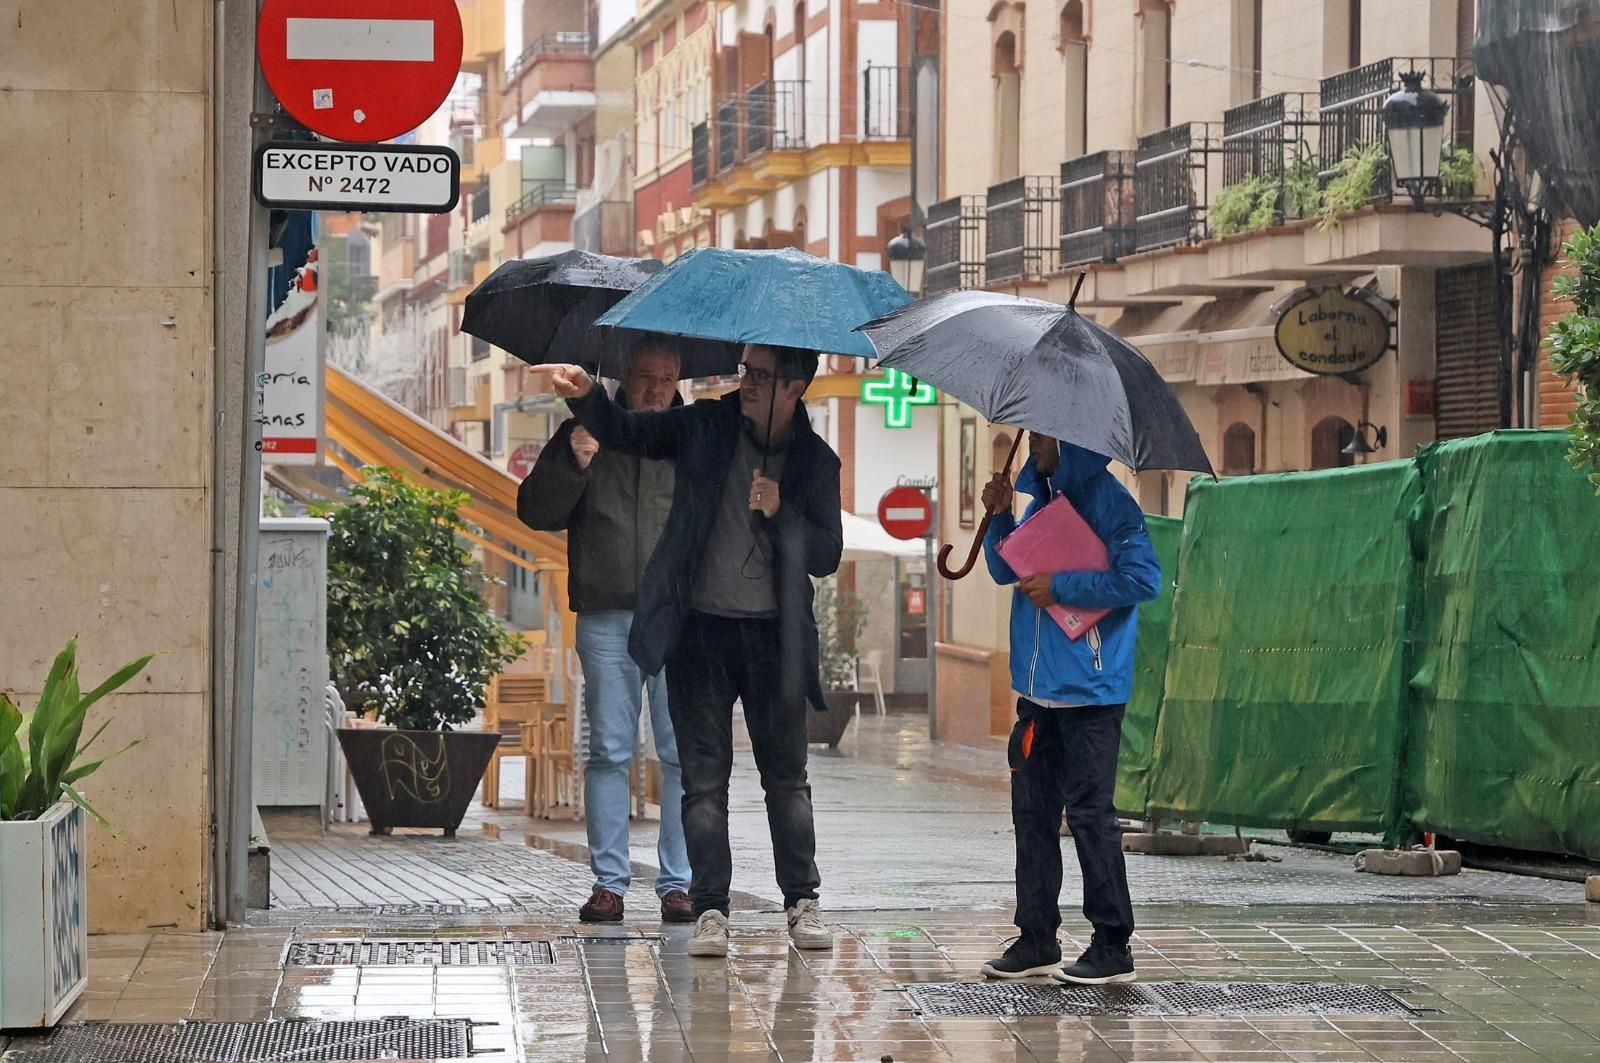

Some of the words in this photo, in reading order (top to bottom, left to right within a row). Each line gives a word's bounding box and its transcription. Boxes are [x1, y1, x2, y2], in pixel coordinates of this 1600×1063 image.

[267, 153, 377, 172] EXCEPTO
[384, 156, 450, 174] VADO
[308, 176, 333, 192] Nº
[340, 177, 391, 194] 2472
